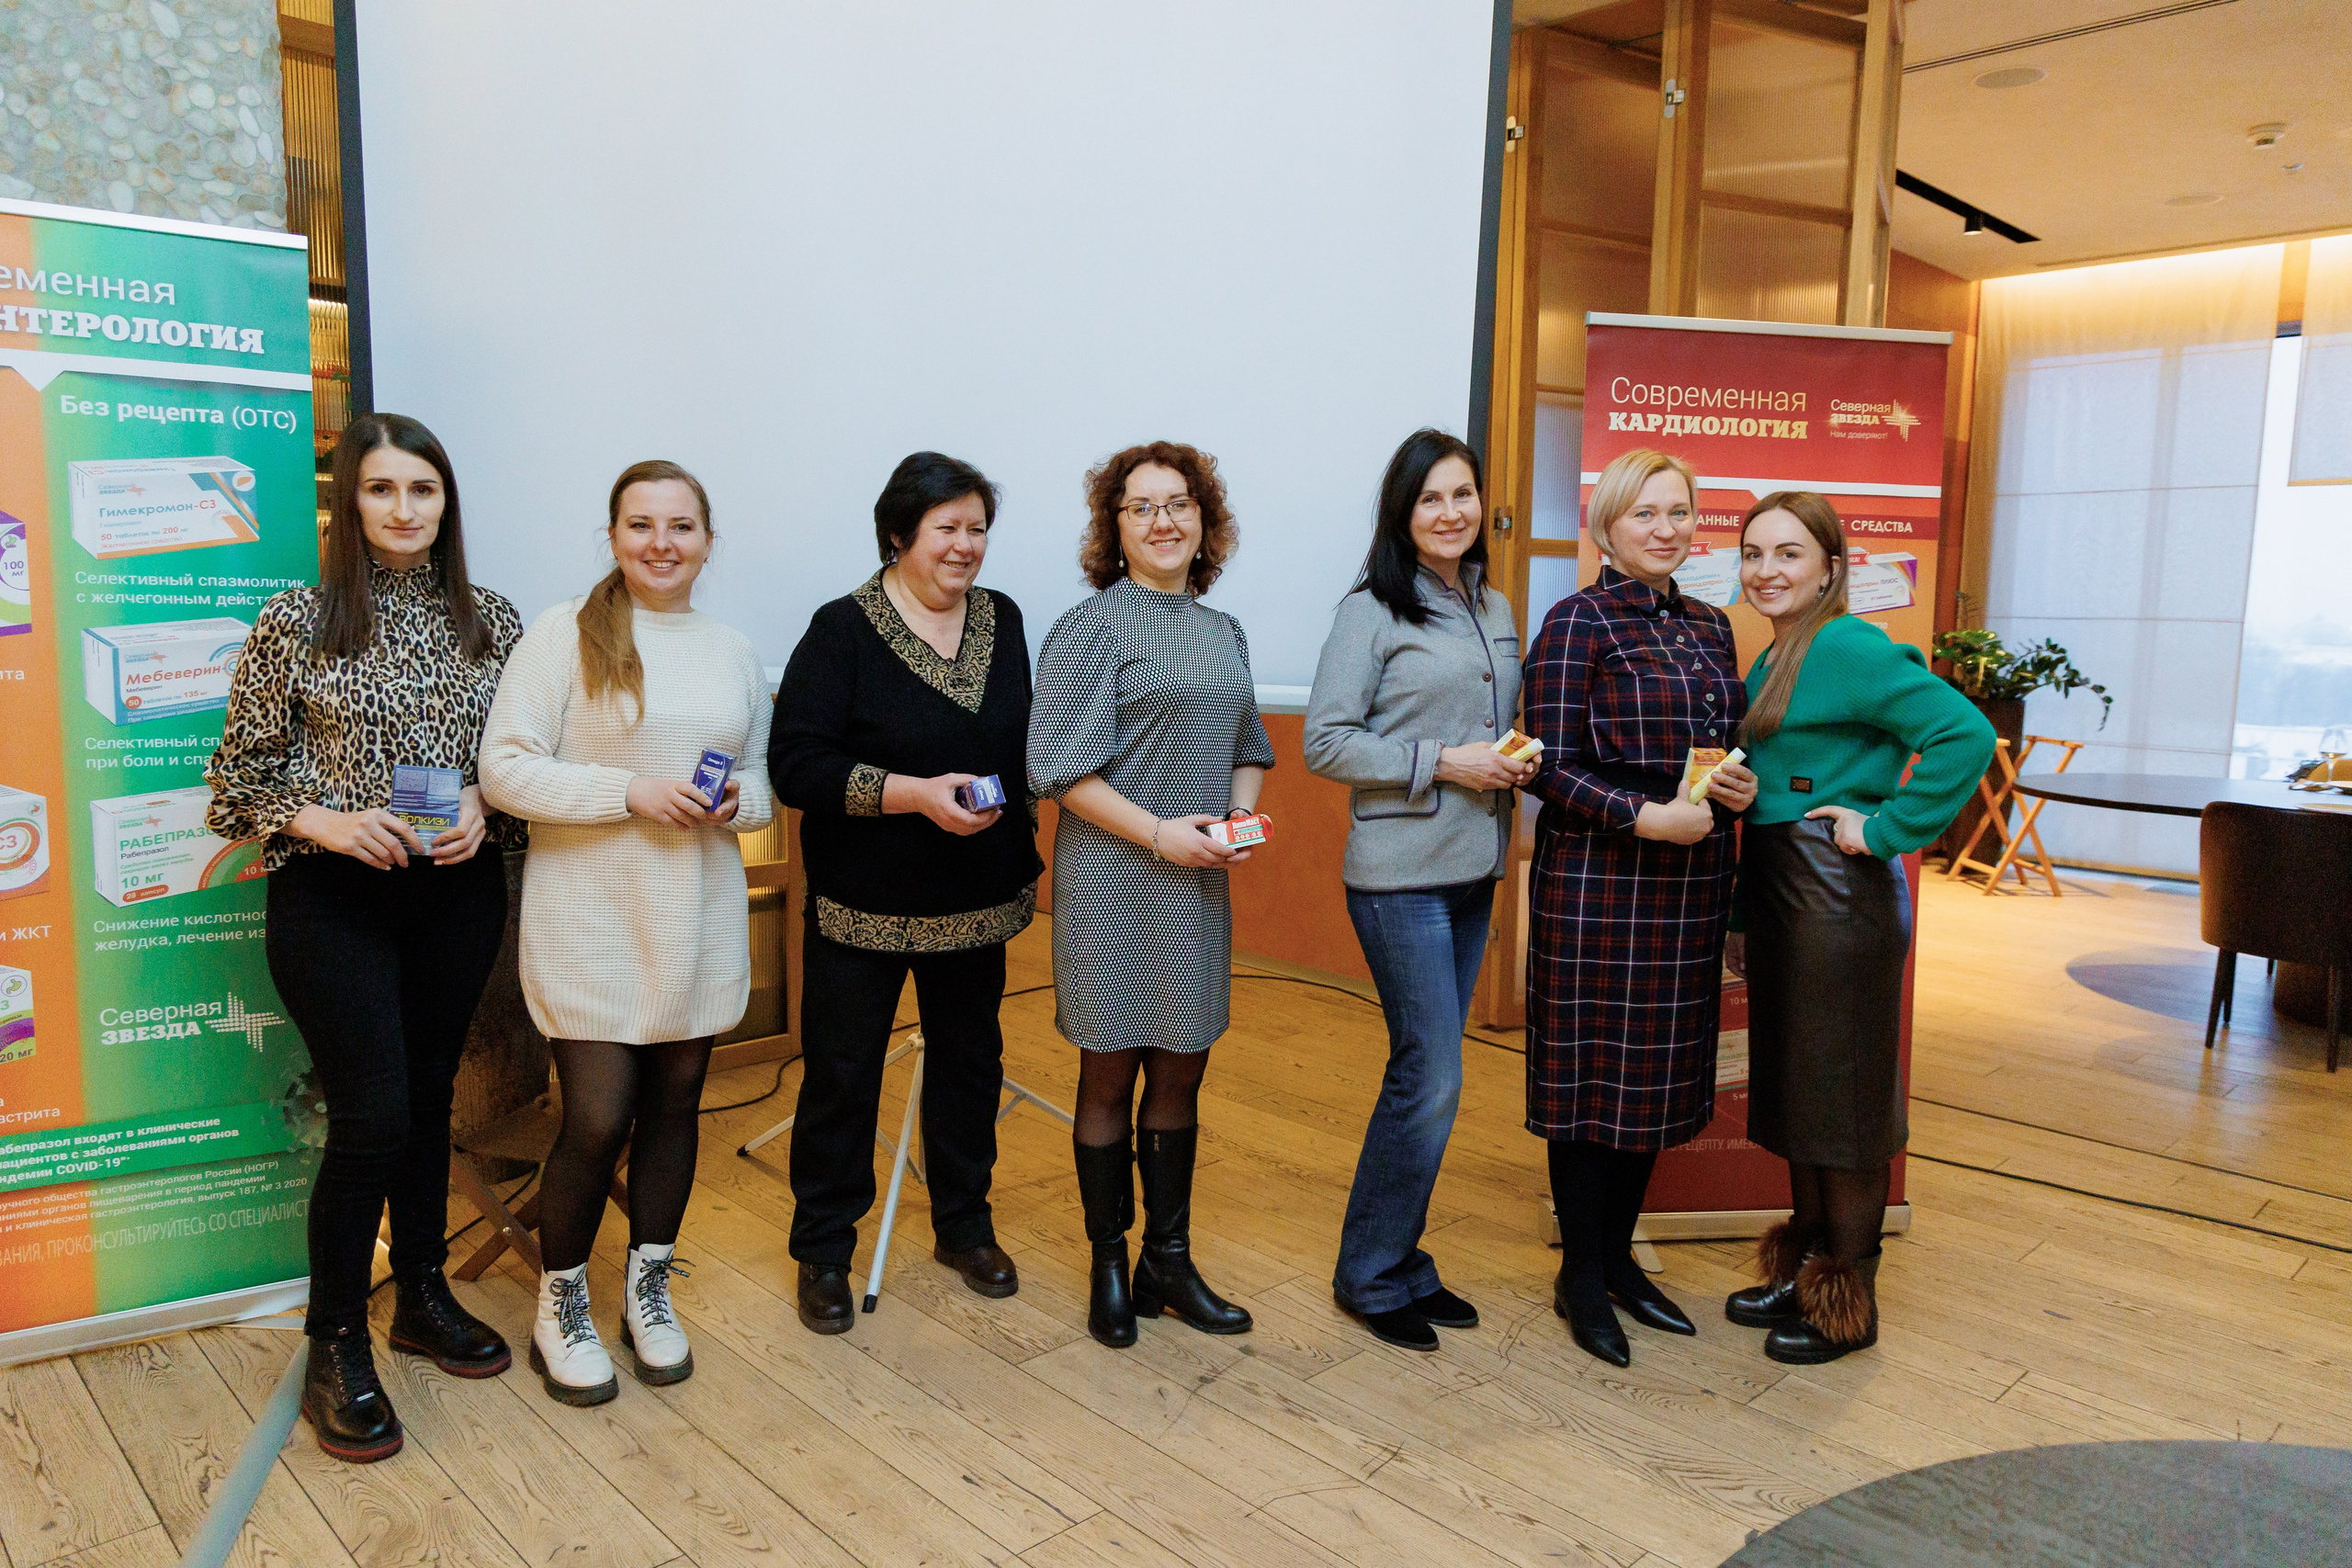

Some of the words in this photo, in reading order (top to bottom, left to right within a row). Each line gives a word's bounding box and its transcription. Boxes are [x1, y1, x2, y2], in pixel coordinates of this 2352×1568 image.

[1611, 377, 1806, 412] Современная
[1830, 399, 1892, 413] Северная
[61, 395, 109, 416] Без
[119, 400, 224, 424] рецепта
[232, 405, 297, 434] (ОТС)
[1830, 412, 1881, 425] ЗВЕЗДА
[1609, 412, 1808, 439] КАРДИОЛОГИЯ
[1696, 514, 1740, 526] АННЫЕ
[1850, 519, 1913, 533] СРЕДСТВА
[162, 526, 178, 535] 200
[4, 560, 24, 570] 100
[74, 570, 194, 588] Селективный
[198, 576, 306, 589] спазмолитик
[76, 592, 86, 603] с
[91, 592, 211, 605] желчегонным
[184, 690, 199, 698] 135
[85, 734, 198, 750] Селективный
[201, 736, 223, 747] сп
[86, 756, 118, 771] при
[123, 754, 164, 767] боли
[169, 756, 179, 765] и
[120, 845, 169, 860] Рабепразол
[244, 866, 257, 875] 10
[121, 875, 140, 888] 10
[145, 873, 164, 885] мг
[126, 892, 137, 900] 28
[140, 887, 165, 897] капсул
[12, 925, 52, 941] ЖКТ
[94, 918, 180, 933] Снижение
[95, 934, 173, 953] желудка,
[176, 930, 243, 945] лечение
[99, 1000, 222, 1027] Северная
[101, 1021, 201, 1045] ЗВЕЗДА
[17, 1048, 33, 1058] мг
[74, 1131, 122, 1145] входят
[137, 1118, 220, 1136] клинические
[71, 1151, 79, 1159] с
[83, 1135, 186, 1157] заболеваниями
[188, 1129, 240, 1145] органов
[42, 1189, 98, 1203] общества
[100, 1173, 202, 1195] гастроэнтерологов
[205, 1168, 242, 1179] России
[244, 1160, 279, 1175] (НОГР)
[16, 1213, 88, 1230] клиническая
[90, 1195, 196, 1219] гастроэнтерология,
[198, 1190, 236, 1202] выпуск
[261, 1182, 273, 1192] №
[284, 1177, 308, 1189] 2020
[41, 1201, 87, 1215] органов
[89, 1190, 163, 1208] пищеварения
[175, 1182, 212, 1194] период
[215, 1176, 266, 1189] пандемии
[47, 1216, 207, 1259] ПРОКОНСУЛЬТИРУЙТЕСЬ
[209, 1213, 227, 1232] СО
